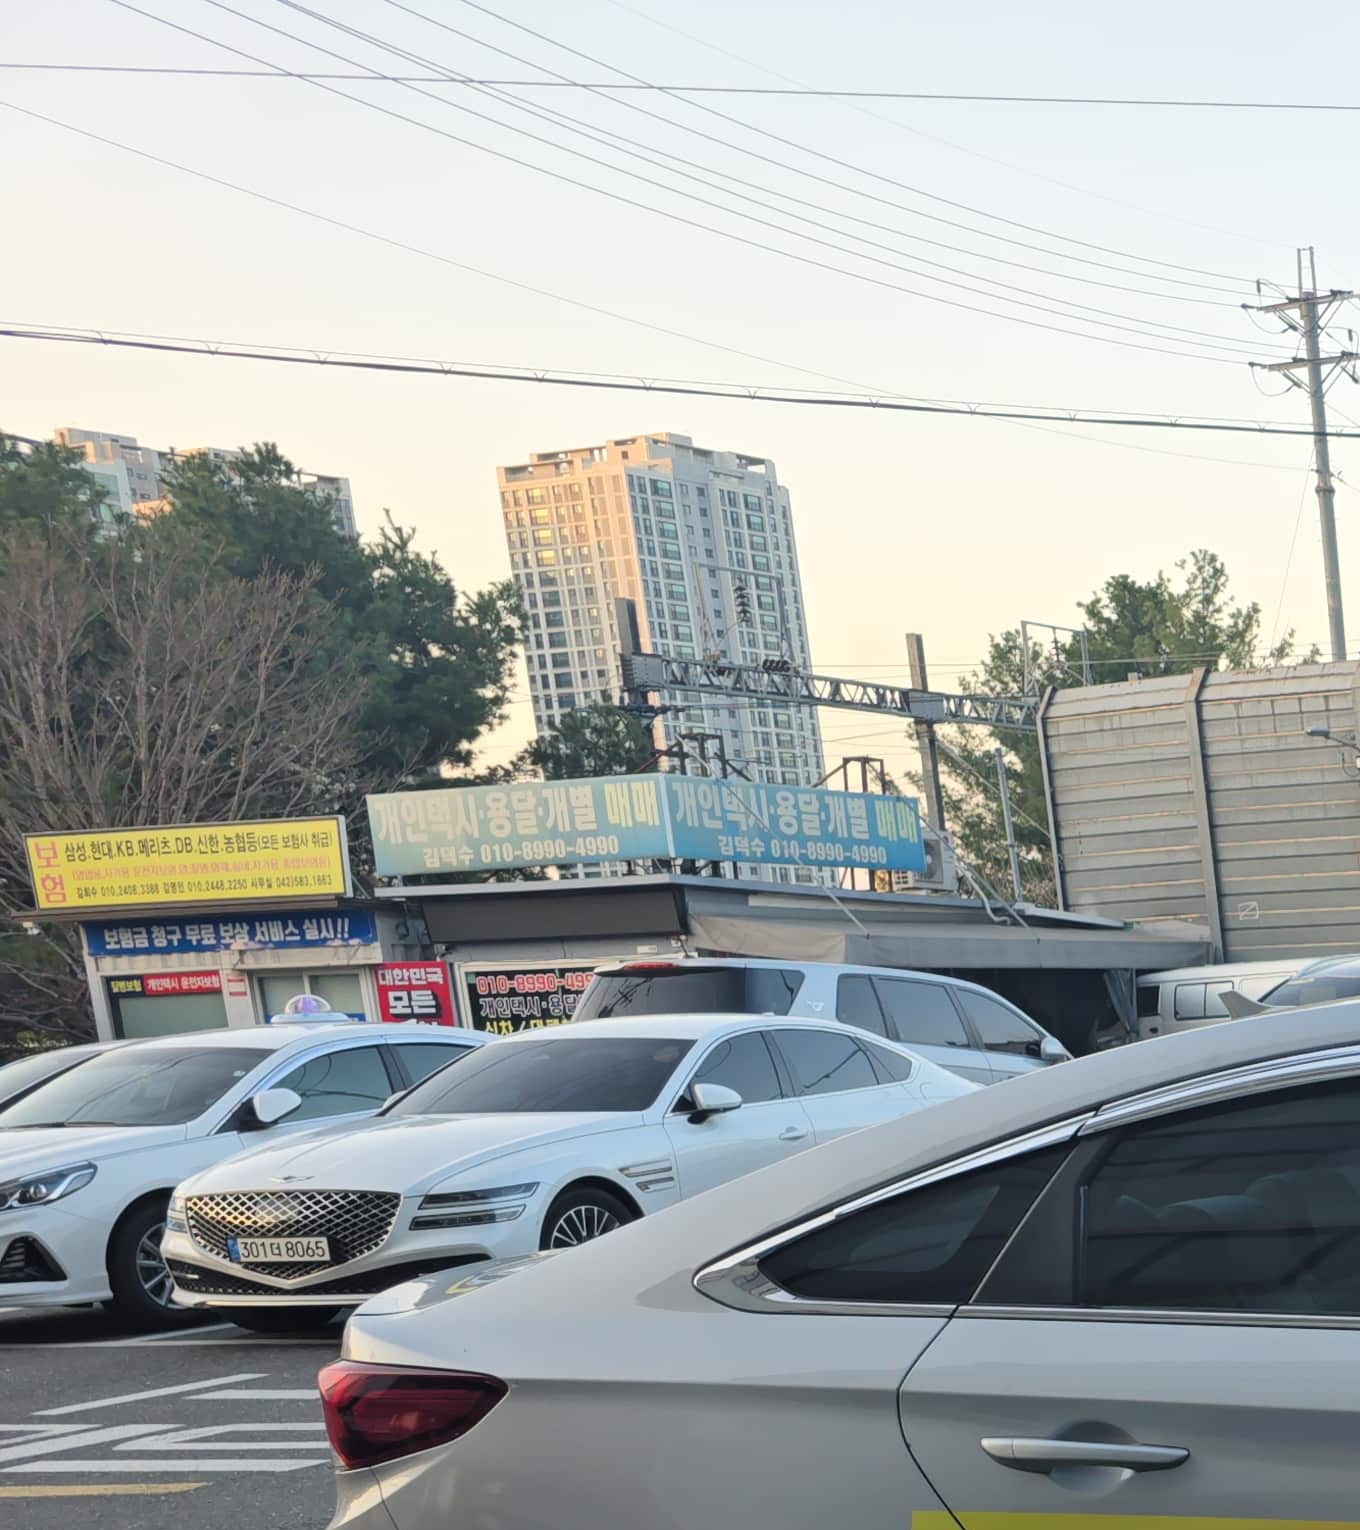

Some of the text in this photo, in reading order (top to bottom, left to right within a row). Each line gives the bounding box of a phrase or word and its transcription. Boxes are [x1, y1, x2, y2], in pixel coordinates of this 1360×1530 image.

[604, 780, 660, 828] 매매
[874, 799, 919, 843] 매매
[282, 834, 308, 849] 보험사
[481, 835, 619, 863] 010-8990-4990
[771, 840, 887, 864] 010-8990-4990
[104, 926, 149, 949] 보험금
[152, 925, 182, 947] 청구
[185, 924, 216, 945] 무료
[254, 919, 300, 942] 서비스
[303, 917, 349, 940] 실시!!
[378, 967, 443, 986] 대한민국
[388, 990, 437, 1015] 모든
[285, 1240, 325, 1258] 8065
